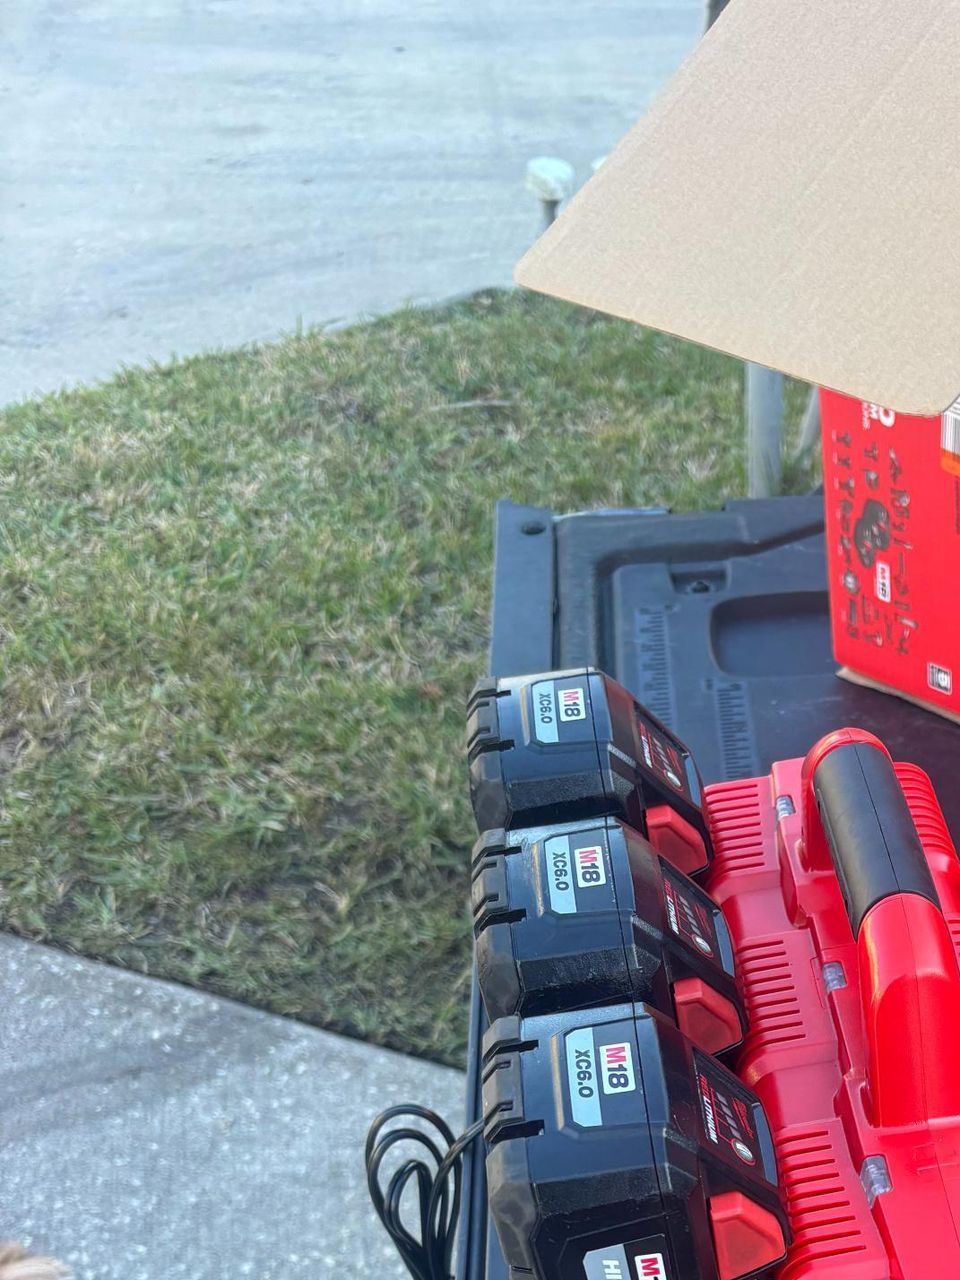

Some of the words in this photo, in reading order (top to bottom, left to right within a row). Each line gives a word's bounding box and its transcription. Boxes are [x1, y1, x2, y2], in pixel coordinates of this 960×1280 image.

[538, 692, 553, 723] XC6.0
[563, 690, 581, 718] M18
[551, 850, 570, 892] XC6.0
[578, 849, 601, 885] M18
[574, 1048, 594, 1099] XC6.0
[604, 1046, 630, 1091] M18
[699, 1074, 719, 1145] REDLITHIUM
